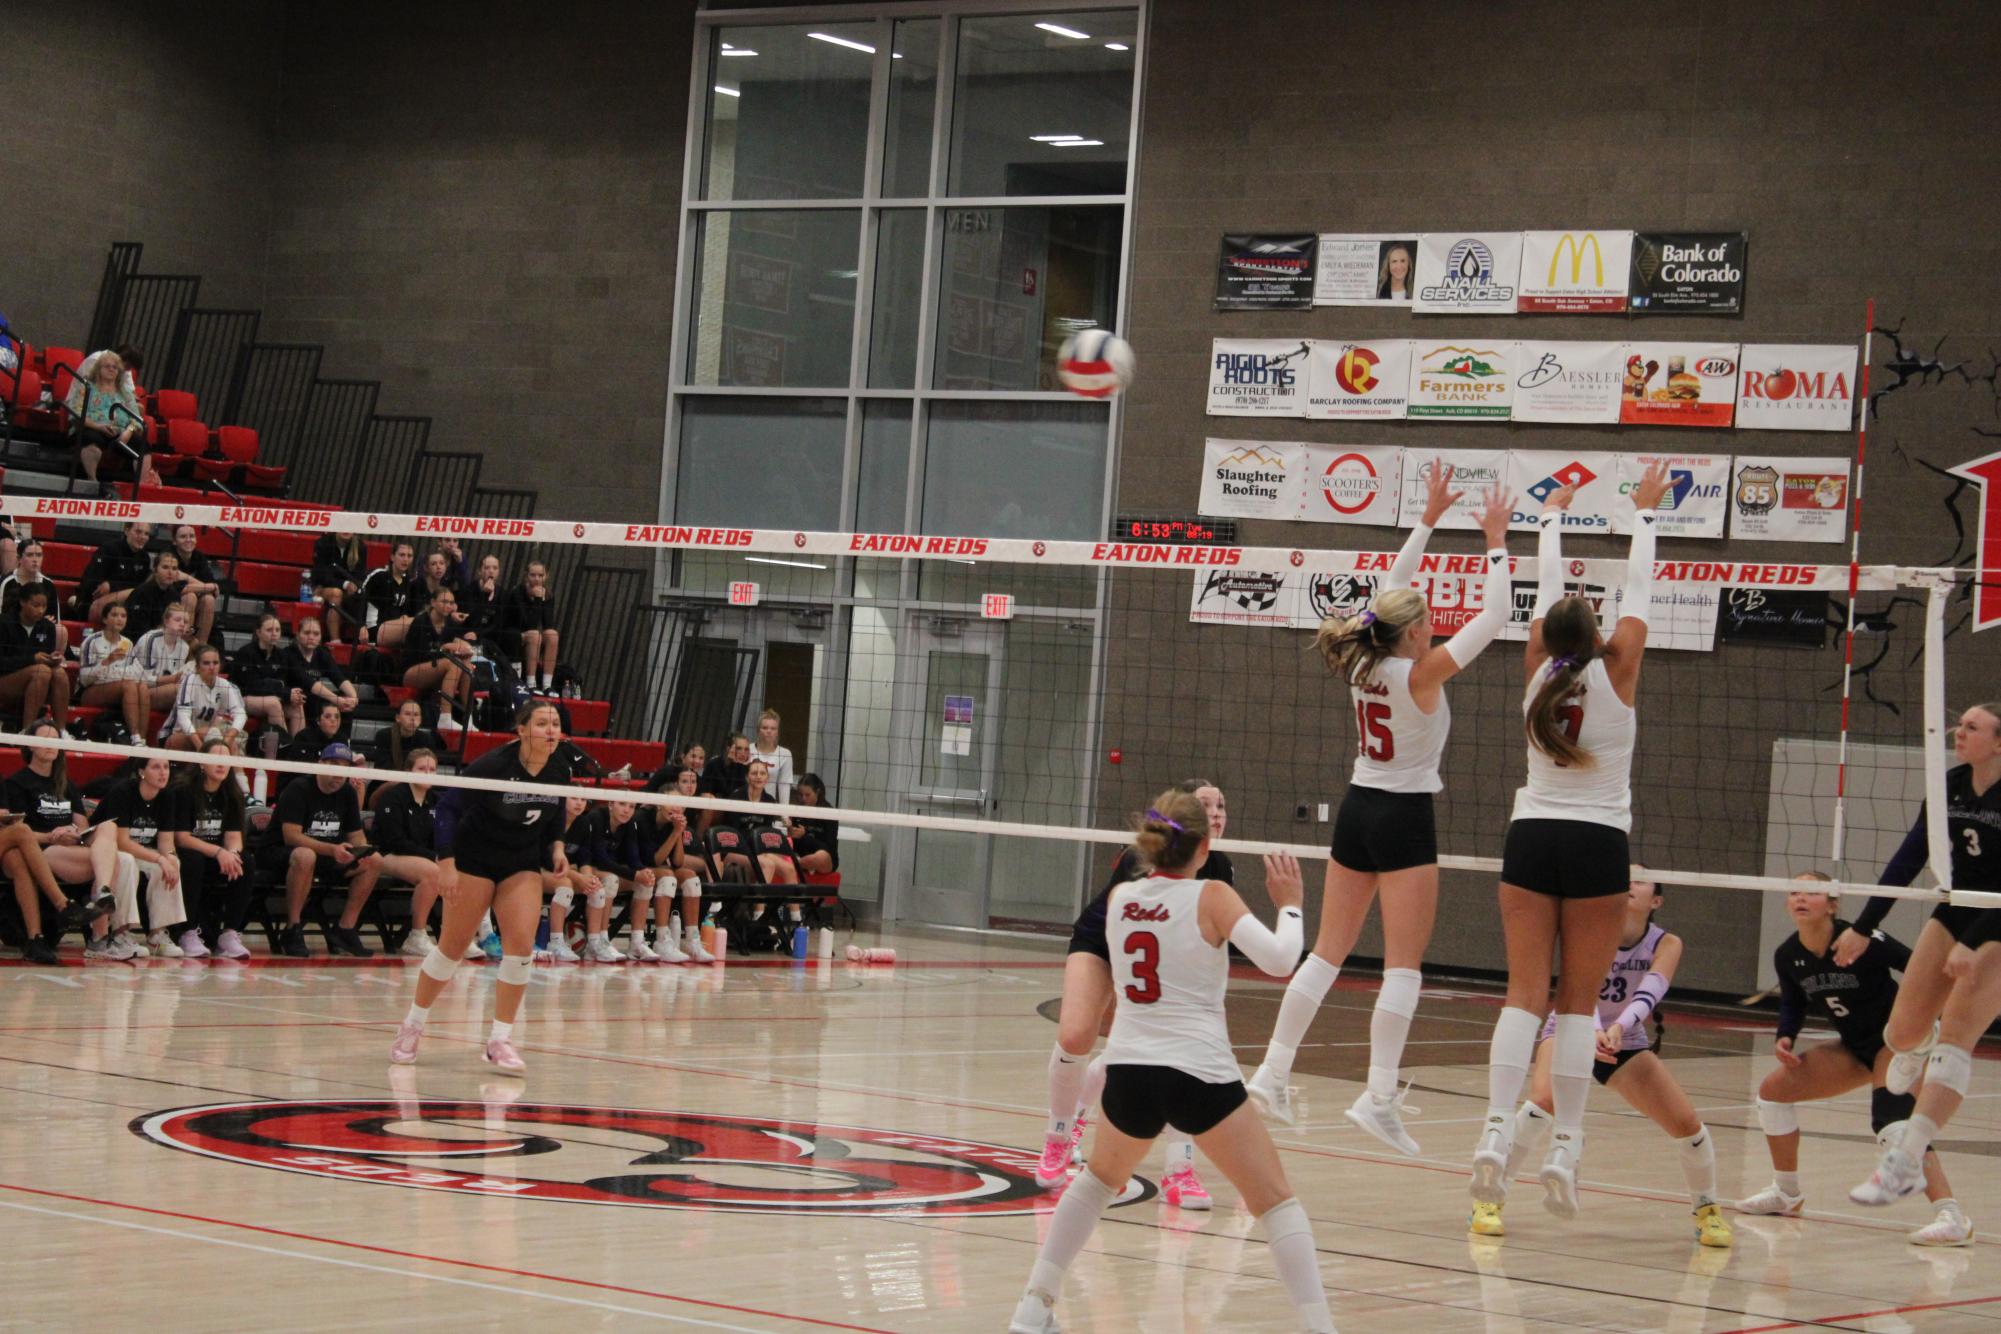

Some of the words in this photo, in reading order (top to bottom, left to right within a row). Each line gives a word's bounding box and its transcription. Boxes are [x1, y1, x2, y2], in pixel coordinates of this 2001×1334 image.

[1662, 243, 1706, 262] Bank
[1708, 243, 1728, 261] of
[1661, 263, 1740, 282] Colorado
[1442, 276, 1497, 289] NAILL
[1421, 287, 1513, 301] SERVICES
[1224, 368, 1296, 385] ROOTS
[1213, 386, 1295, 396] CONSTRUCTION
[1420, 380, 1505, 393] Farmers
[1342, 398, 1372, 406] ROOFING
[1436, 393, 1488, 401] BANK
[1742, 400, 1848, 410] RESTAURANT
[1216, 468, 1286, 484] Slaughter
[1418, 462, 1499, 480] GANDVIEW
[1222, 483, 1278, 500] Roofing
[1321, 478, 1380, 490] SCOOTER'S
[1690, 485, 1722, 498] AIR
[1334, 490, 1363, 498] COFFEE
[1743, 485, 1770, 505] 85
[35, 499, 92, 515] EATON
[94, 502, 141, 518] REDS
[219, 507, 278, 524] EATON
[281, 511, 331, 527] REDS
[415, 516, 479, 533] EATON
[481, 519, 535, 536] REDS
[1510, 512, 1608, 527] Doino's
[624, 526, 693, 543] EATON
[694, 529, 754, 546] REDS
[1131, 522, 1170, 538] 6:53
[849, 535, 924, 552] EATON
[926, 537, 989, 555] REDS
[1092, 543, 1171, 562] EATON
[1174, 546, 1242, 565] REDS
[1354, 552, 1441, 573] EATN
[1443, 555, 1518, 574] RES
[1652, 562, 1734, 582] ATON
[1737, 564, 1818, 585] REDS
[733, 584, 753, 603] EXIT
[1221, 579, 1274, 591] Automotive
[986, 595, 1008, 617] EXIT
[1357, 699, 1395, 762] 15
[522, 809, 542, 825] 7
[1963, 828, 1982, 856] 3
[1120, 902, 1170, 922] Reds
[1123, 931, 1162, 1004] 3
[1599, 976, 1627, 1003] 23
[1825, 996, 1850, 1017] 5
